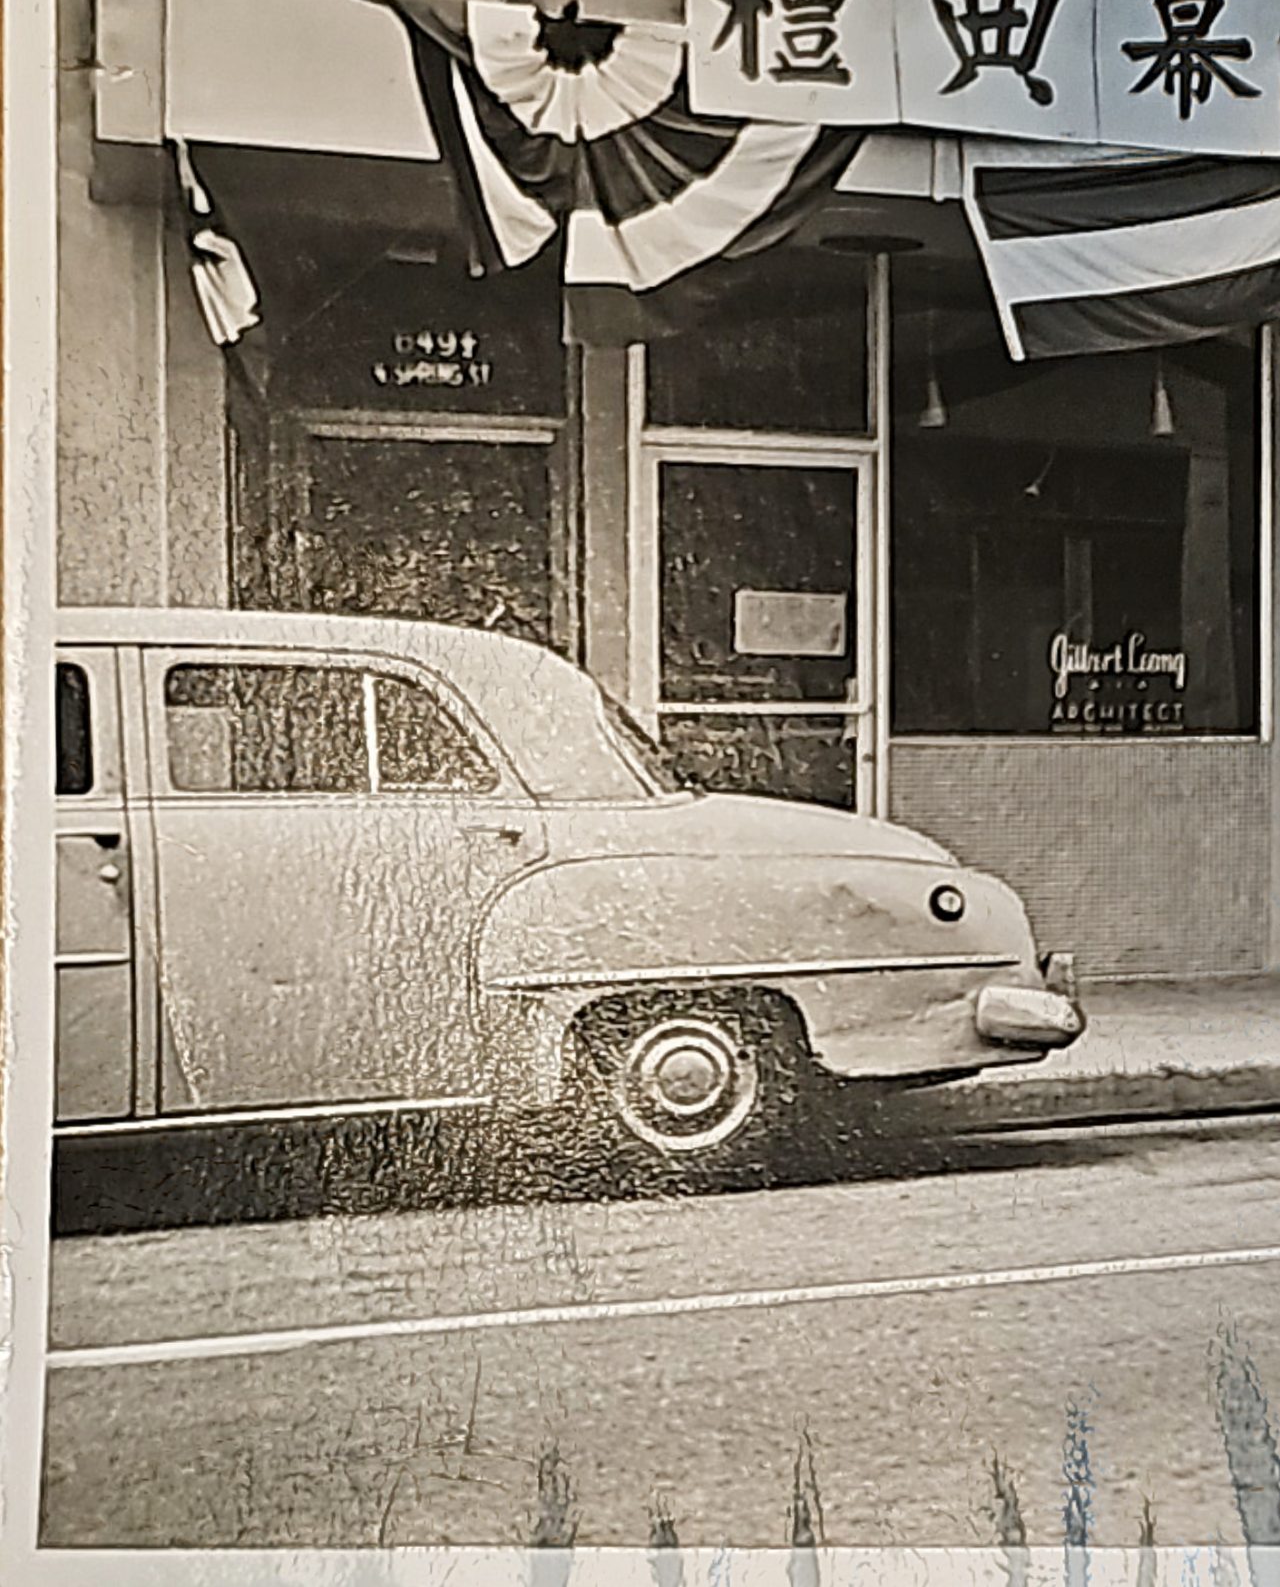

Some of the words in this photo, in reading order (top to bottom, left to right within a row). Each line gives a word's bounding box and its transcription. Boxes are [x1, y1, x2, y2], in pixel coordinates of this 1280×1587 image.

[1050, 633, 1124, 699] Gilbert
[1127, 631, 1186, 690] Leong
[1051, 702, 1184, 723] ARCHITECT
